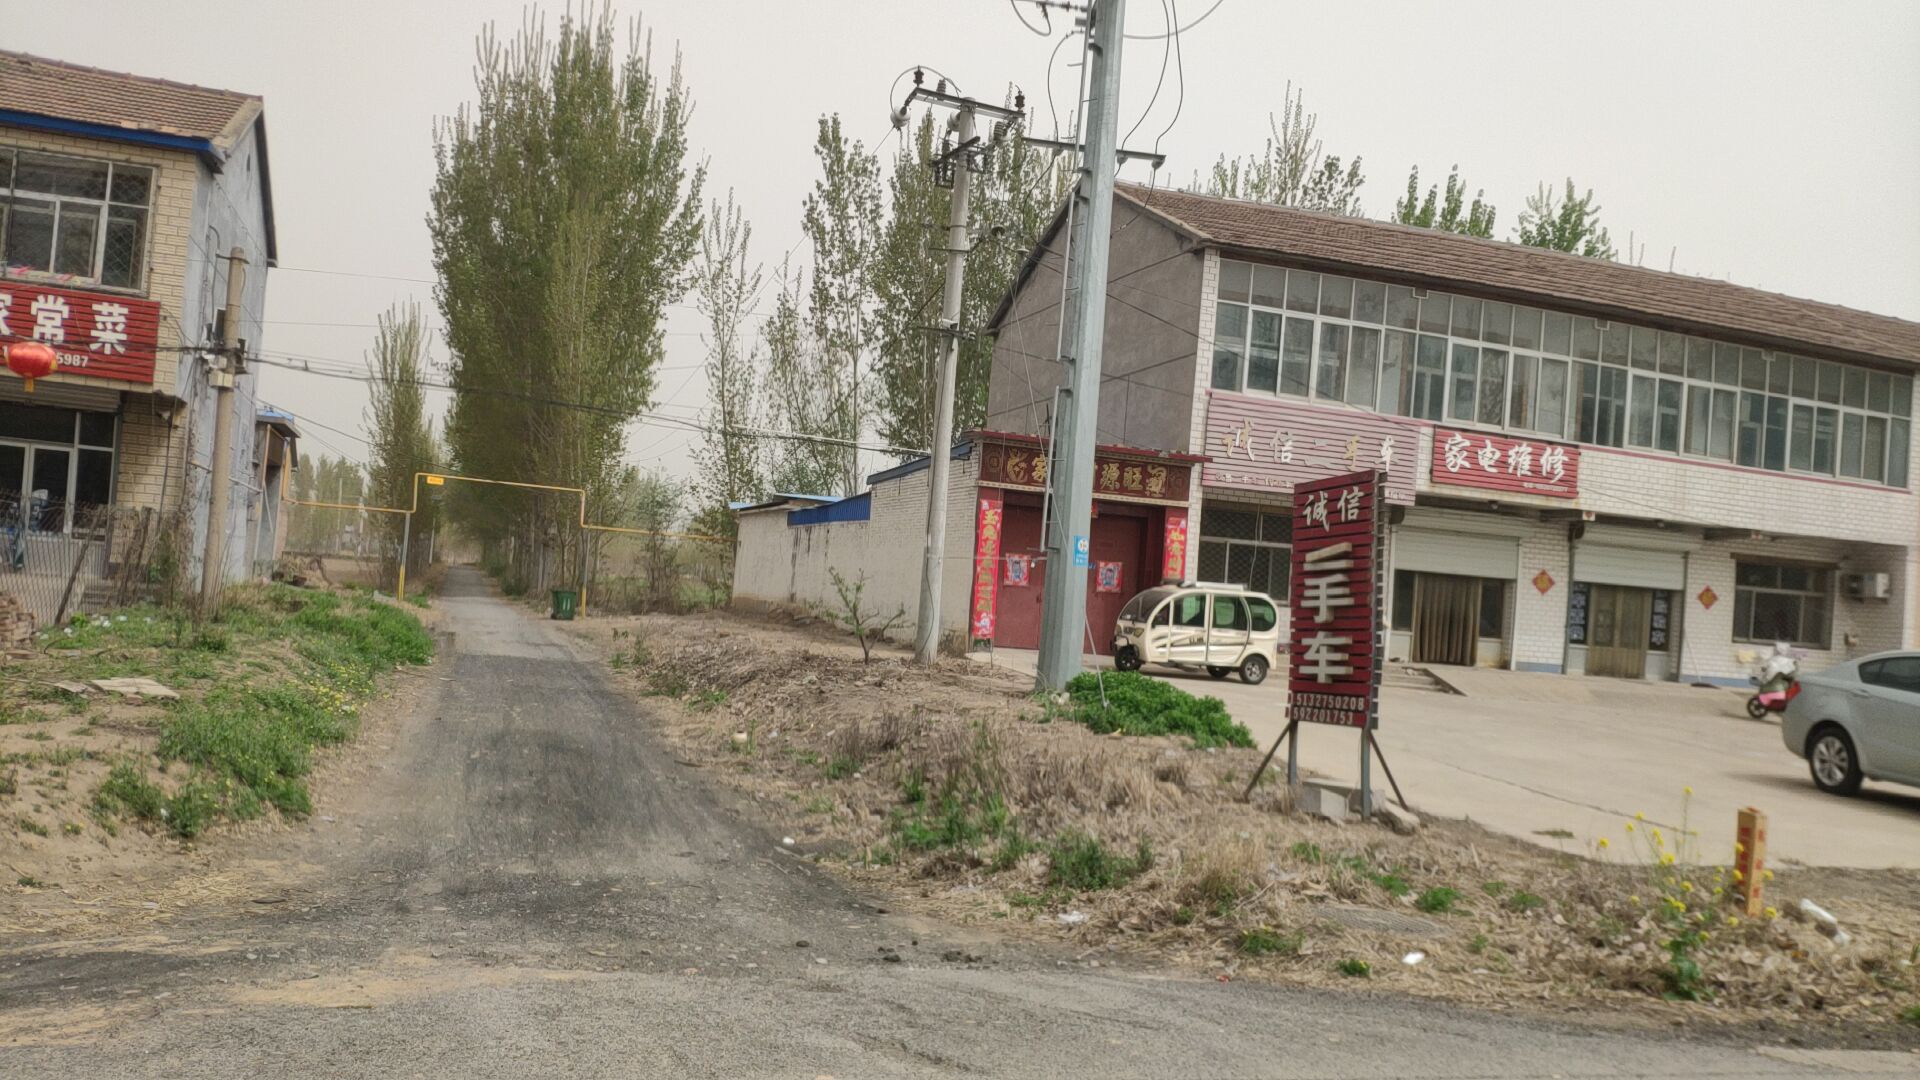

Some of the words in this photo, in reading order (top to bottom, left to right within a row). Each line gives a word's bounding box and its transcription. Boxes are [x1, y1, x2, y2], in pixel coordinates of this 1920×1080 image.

[1444, 432, 1569, 483] 家电维修
[1303, 487, 1364, 532] 诚信
[1299, 542, 1354, 684] 二手车
